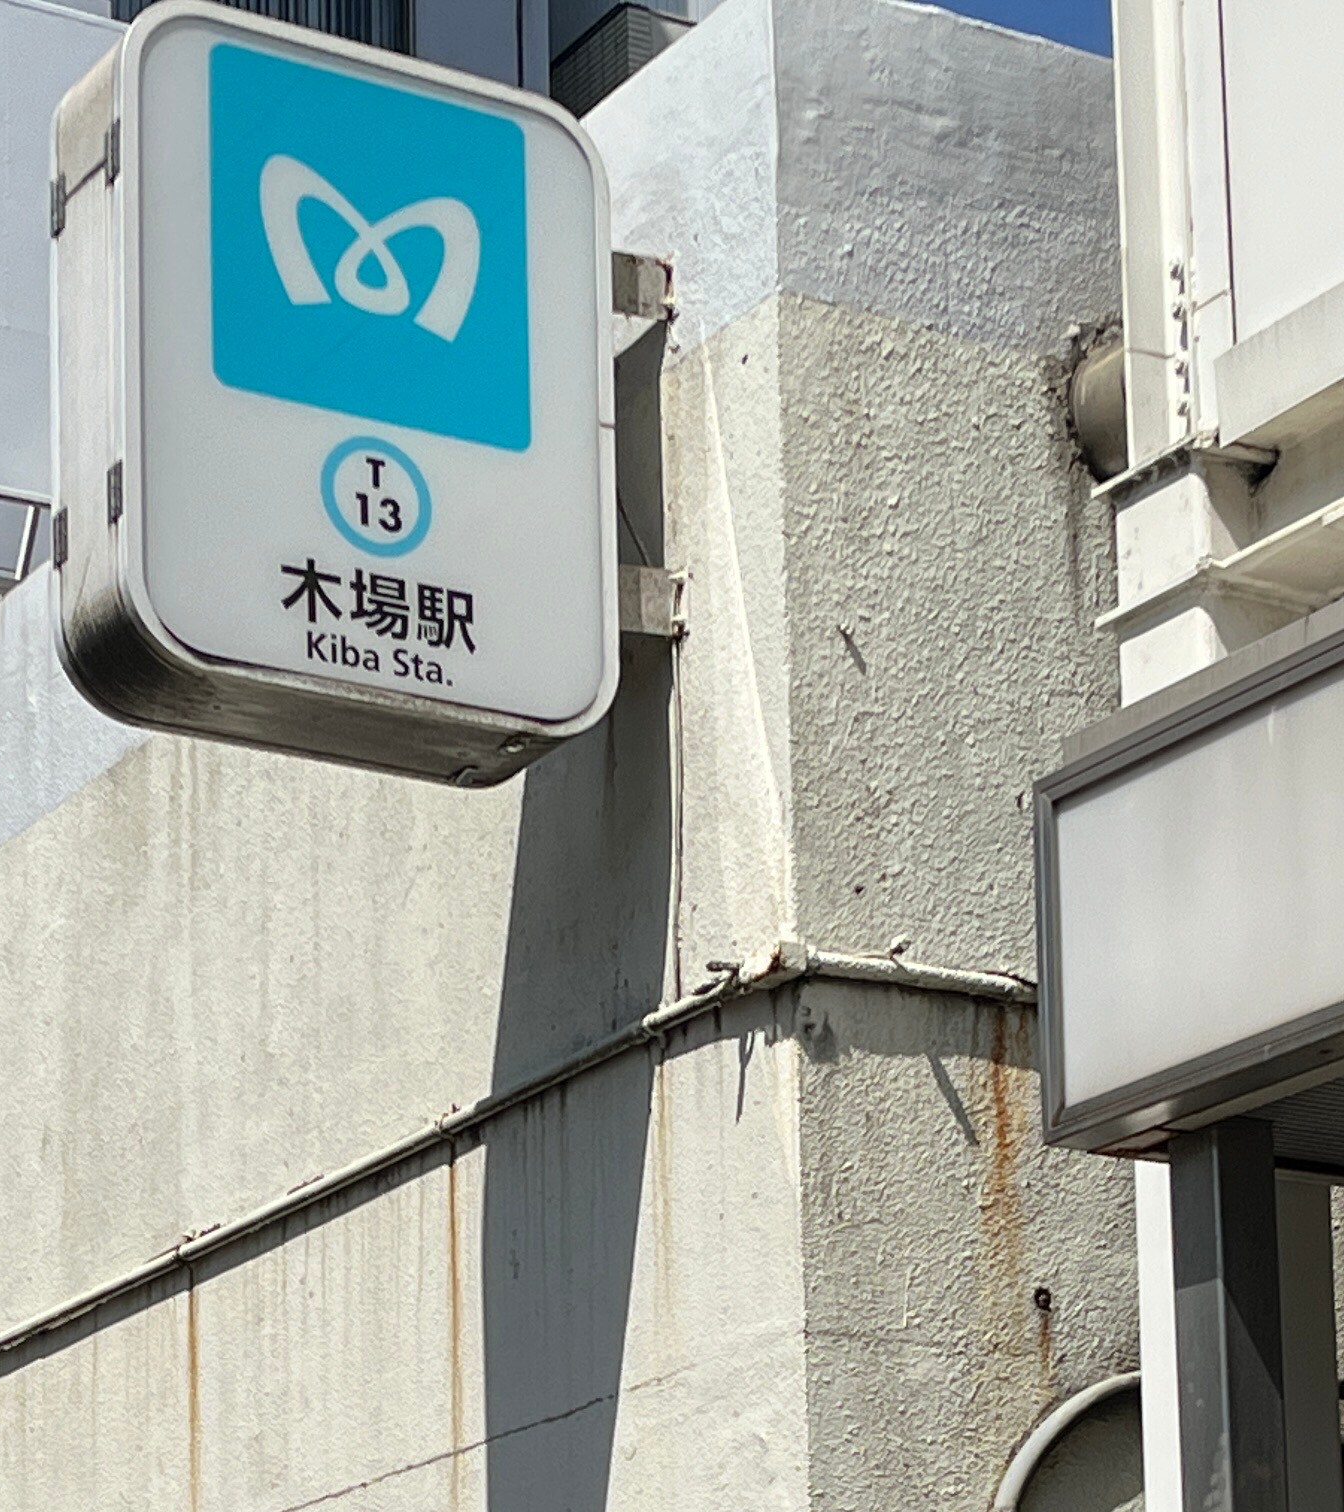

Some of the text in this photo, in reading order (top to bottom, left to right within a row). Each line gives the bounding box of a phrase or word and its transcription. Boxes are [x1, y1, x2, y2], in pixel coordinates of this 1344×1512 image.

[366, 456, 386, 489] T
[356, 491, 403, 533] 13
[280, 558, 476, 654] 木場駅
[307, 631, 454, 687] Kiba Sta.
